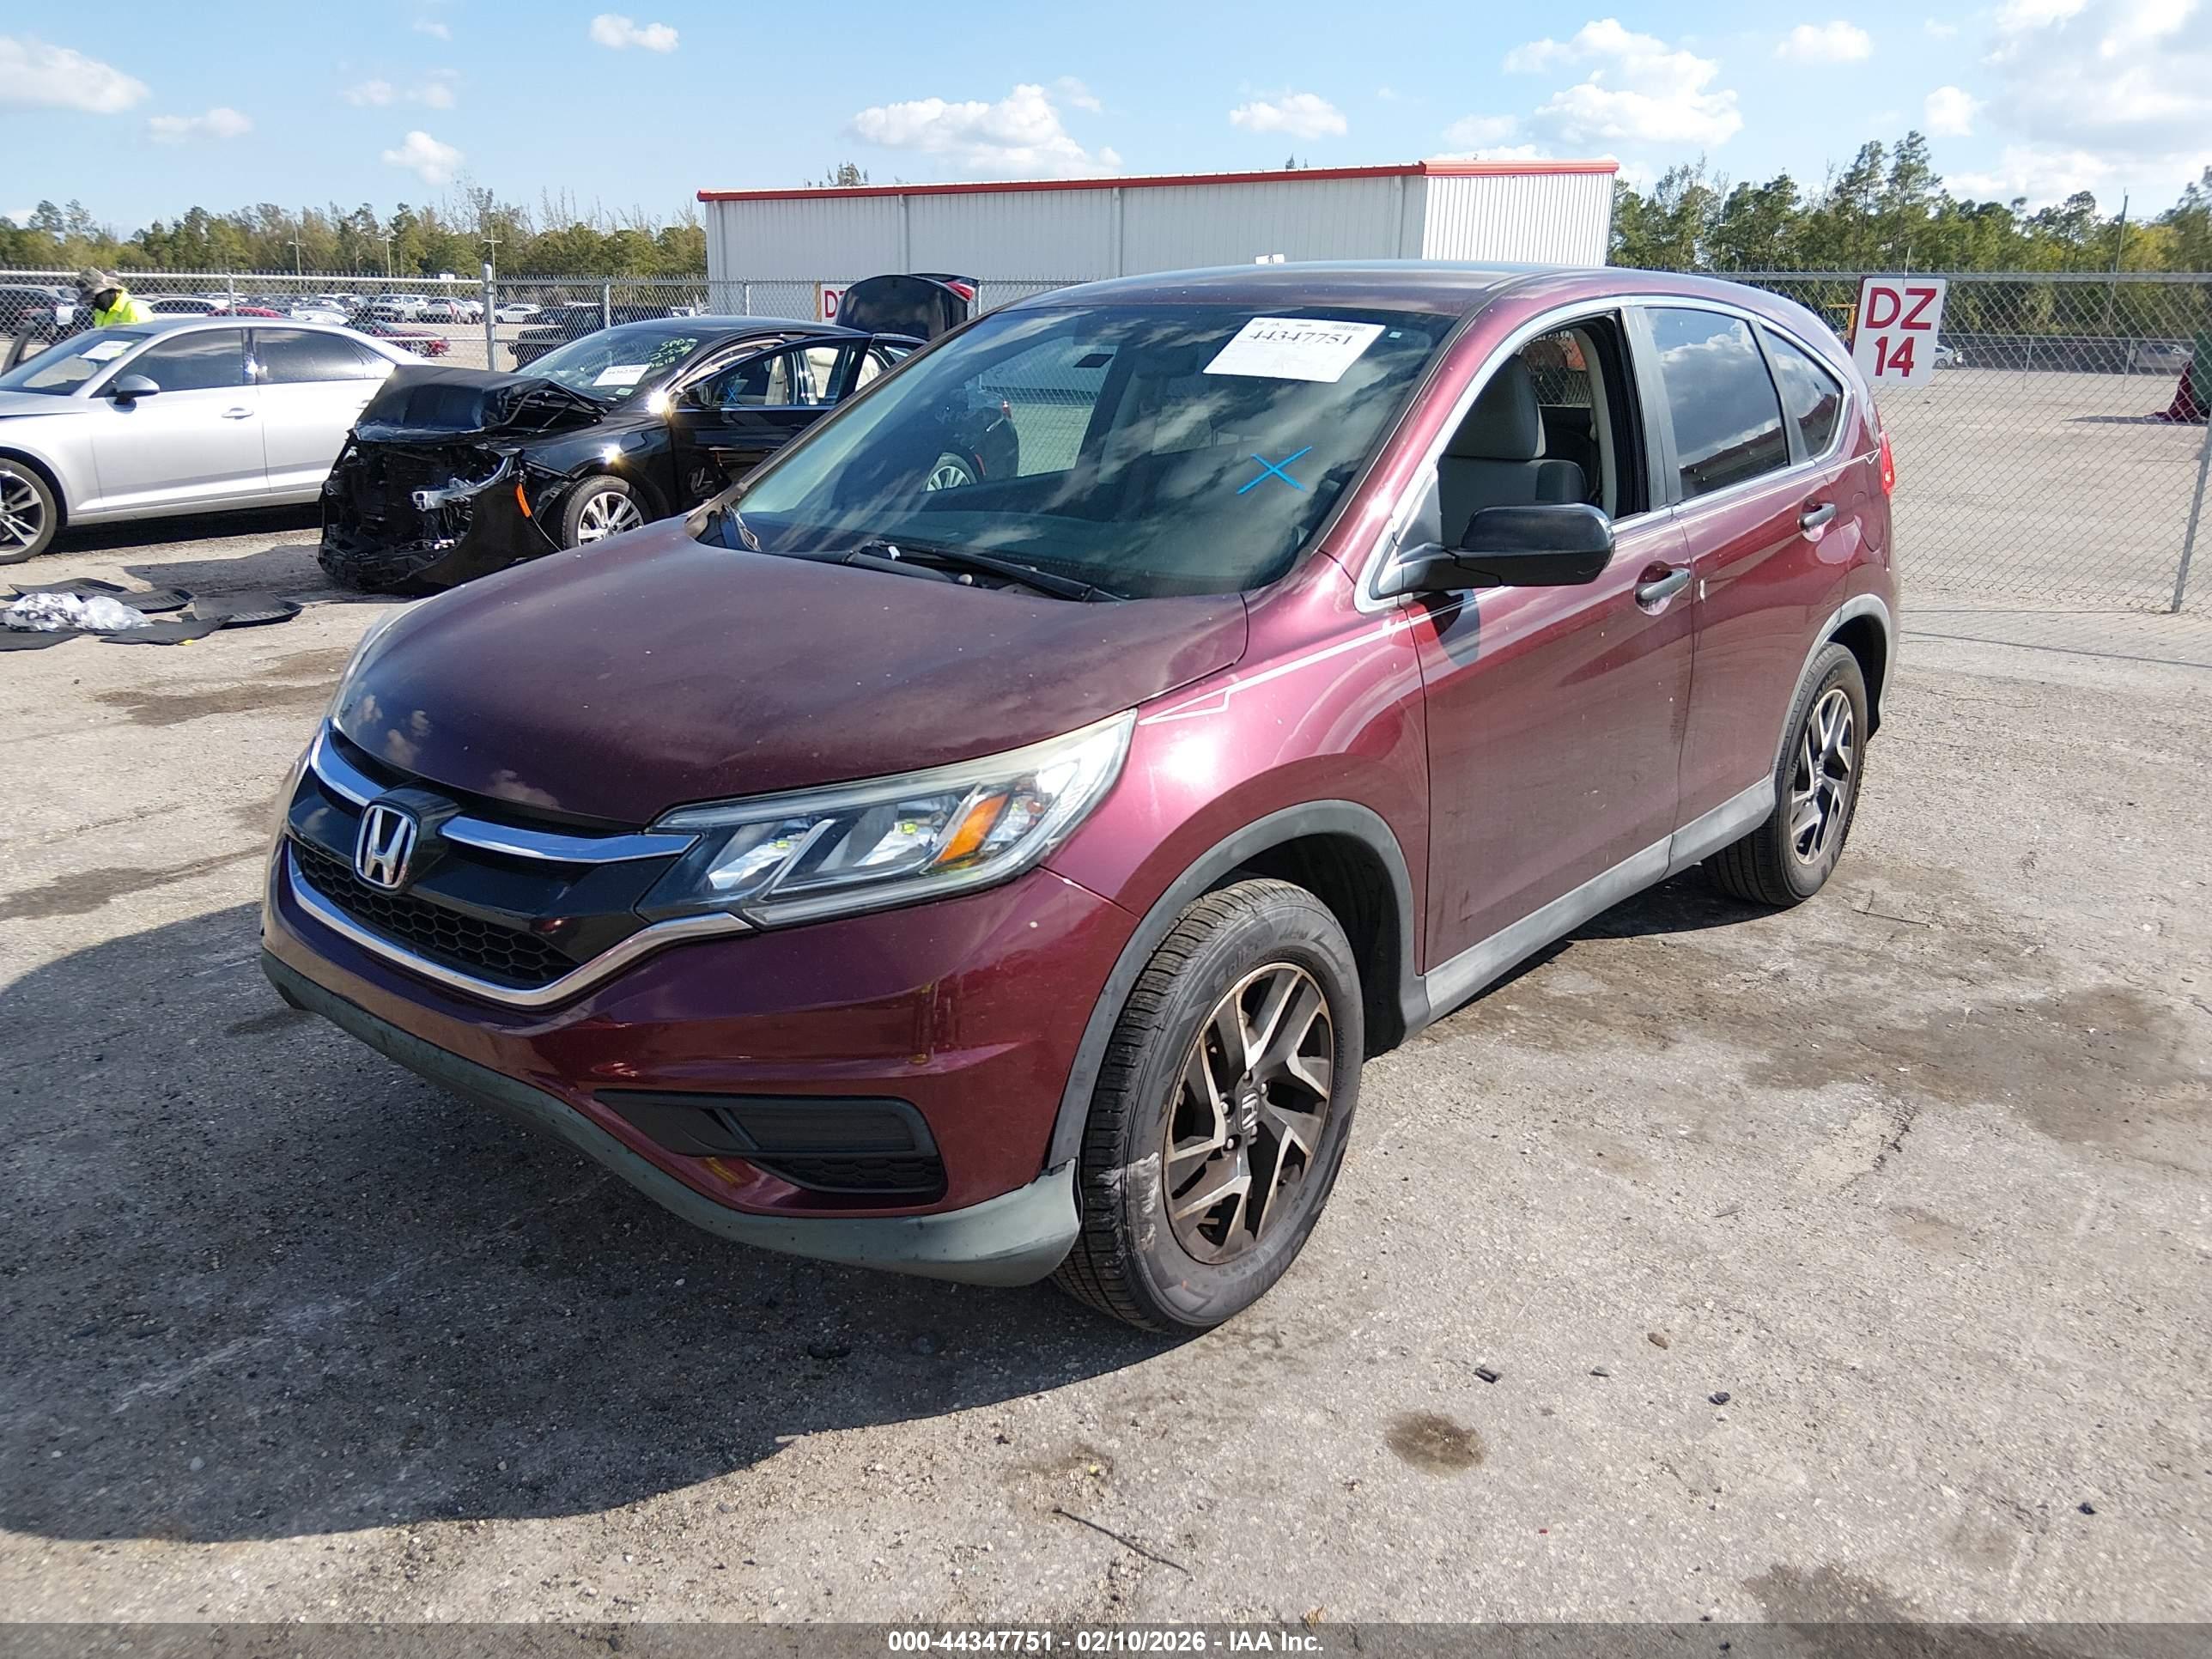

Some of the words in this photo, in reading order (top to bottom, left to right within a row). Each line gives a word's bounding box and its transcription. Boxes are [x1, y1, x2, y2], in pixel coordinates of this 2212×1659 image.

[824, 290, 846, 319] D
[1865, 287, 1937, 331] DZ
[1249, 330, 1353, 345] 44347751
[1875, 336, 1915, 378] 14
